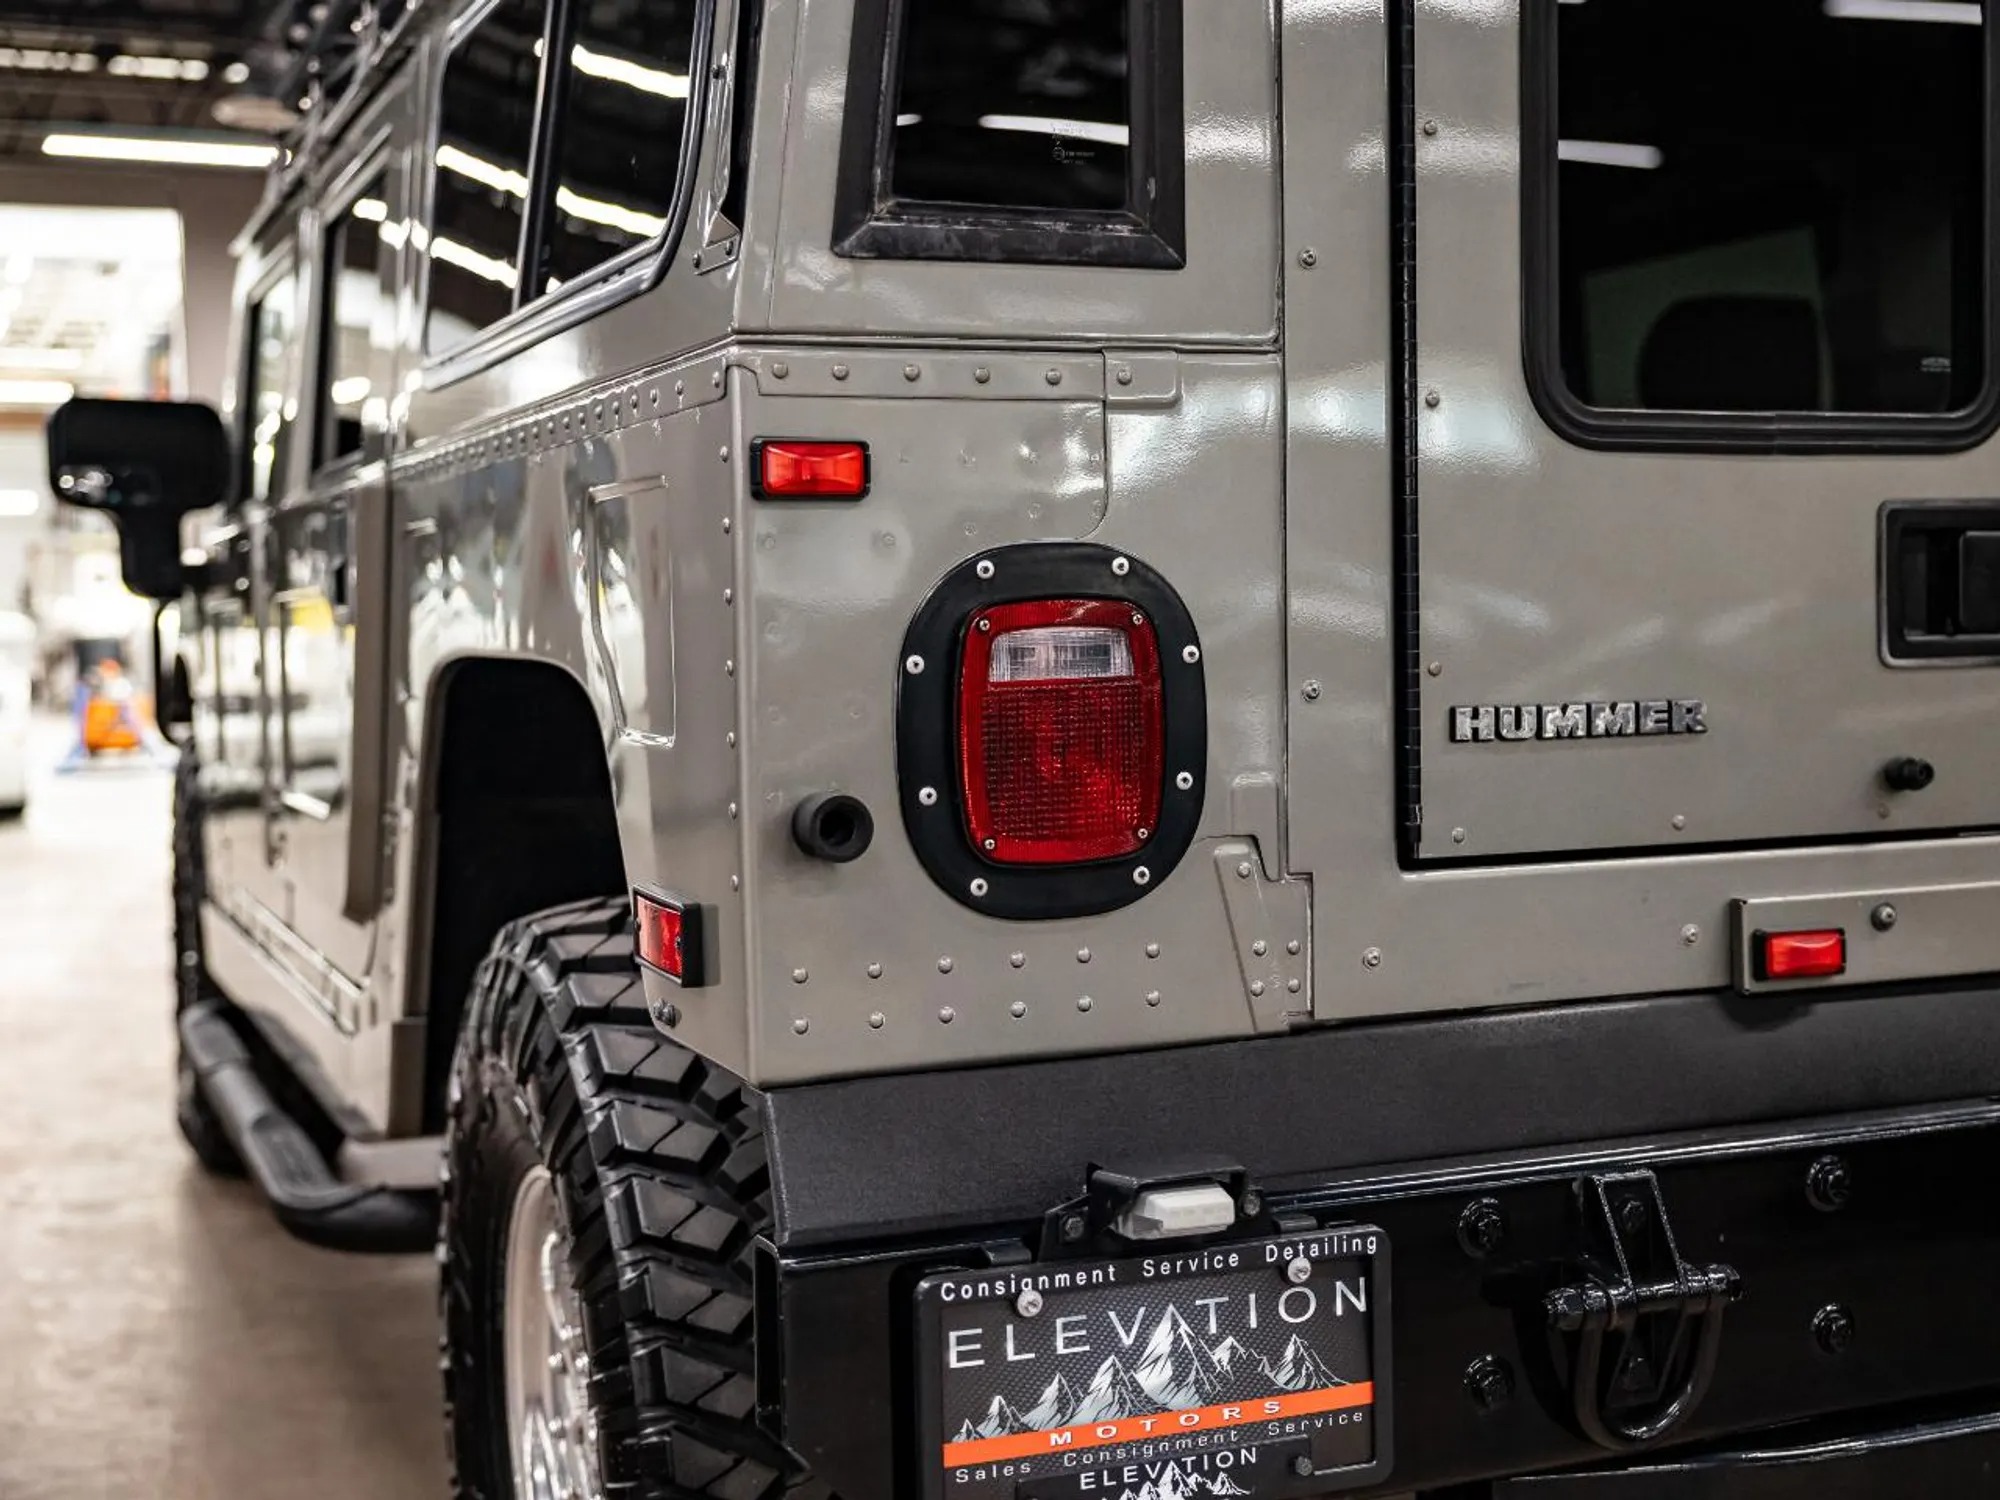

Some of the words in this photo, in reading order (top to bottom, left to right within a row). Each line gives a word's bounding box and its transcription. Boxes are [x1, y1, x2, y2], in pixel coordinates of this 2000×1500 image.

[1450, 700, 1708, 742] HUMMER
[941, 1264, 1116, 1301] Consignment
[1143, 1252, 1240, 1277] Service
[1265, 1235, 1377, 1262] Detailing
[955, 1462, 1031, 1483] Sales
[1064, 1429, 1238, 1467] Consignment
[1268, 1411, 1363, 1436] Service
[1050, 1401, 1280, 1446] MOTORS
